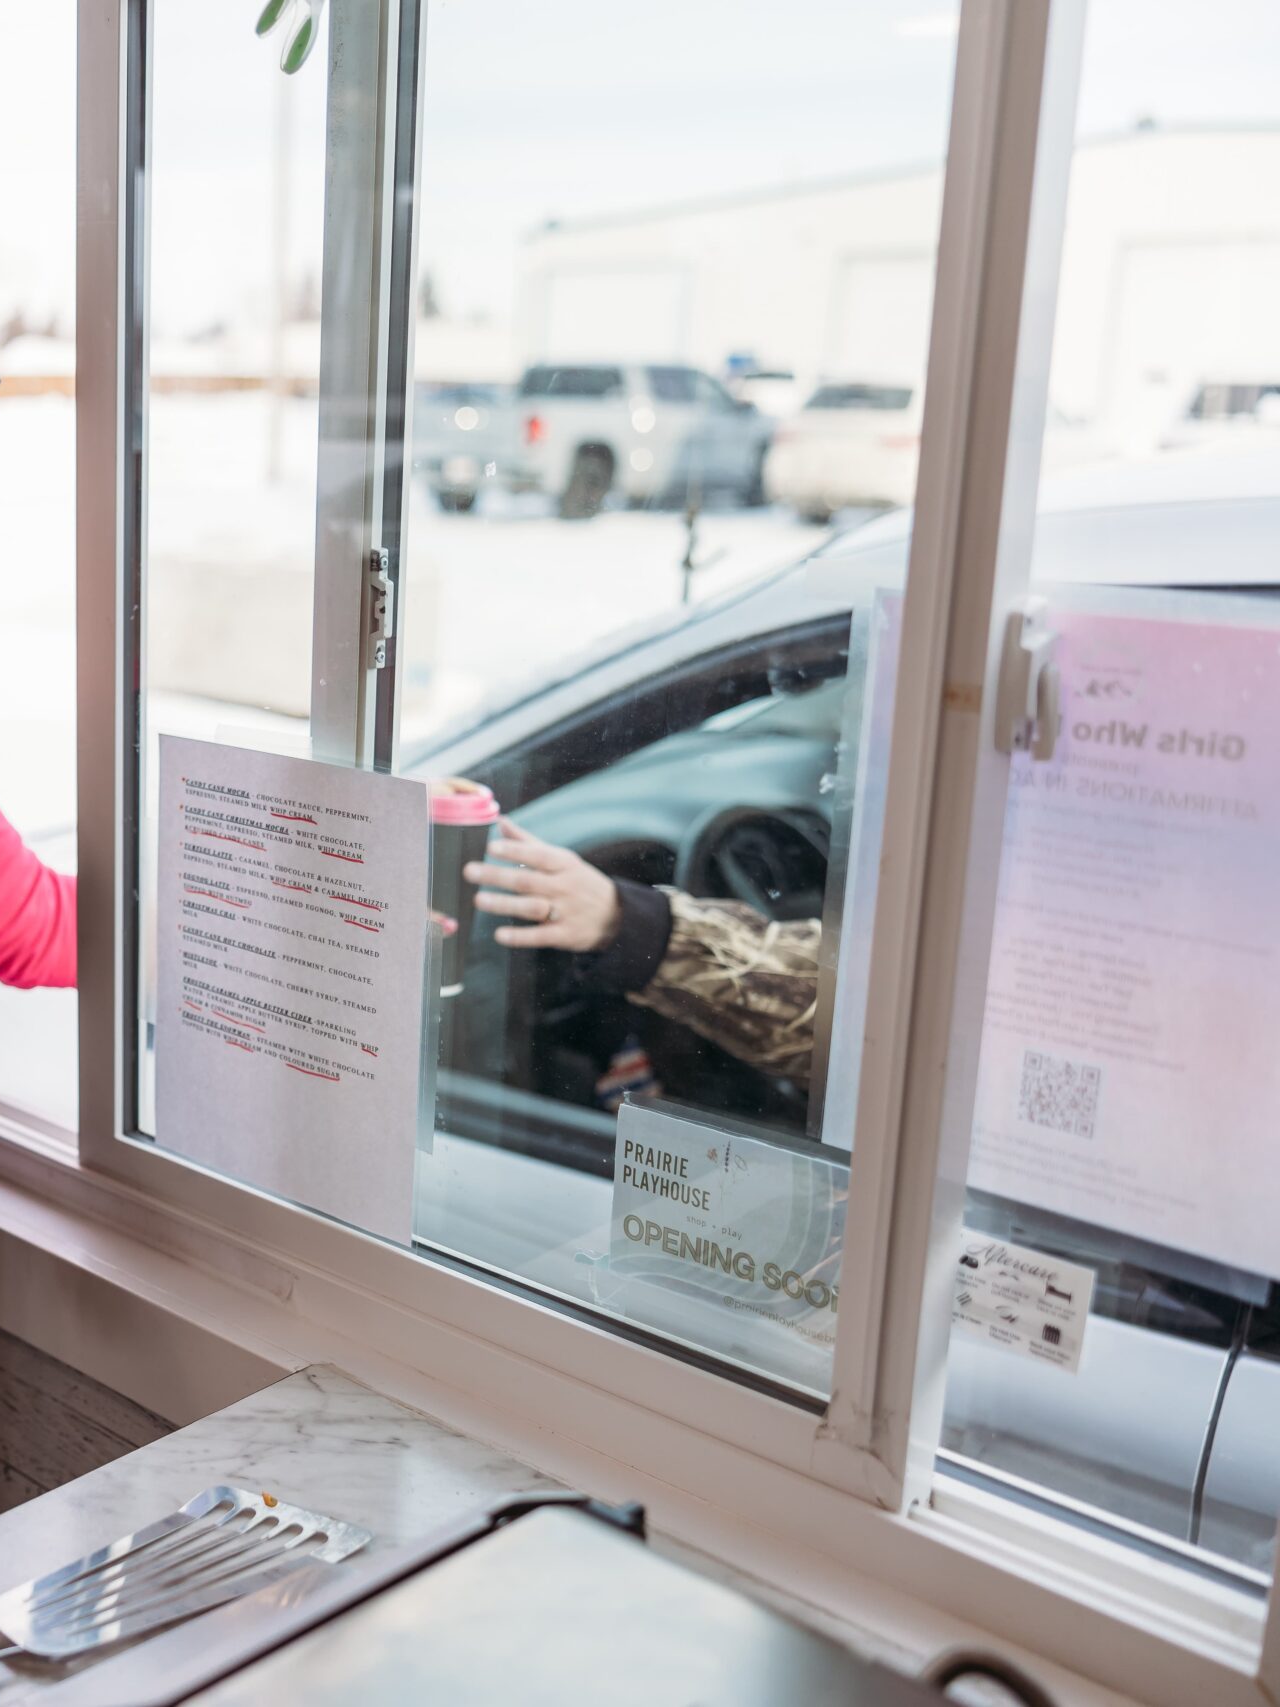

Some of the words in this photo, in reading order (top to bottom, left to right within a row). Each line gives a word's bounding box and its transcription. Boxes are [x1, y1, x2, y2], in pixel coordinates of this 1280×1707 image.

[220, 796, 249, 807] STEAMED
[251, 803, 267, 811] MILK
[270, 807, 287, 815] WHIP
[289, 809, 312, 820] CREAM
[227, 788, 250, 799] MOCHA
[256, 794, 295, 807] CHOCOLATE
[299, 803, 323, 813] SAUCE,
[325, 808, 372, 823] PEPPERMINT,
[226, 814, 263, 830] CHRISTMAS
[265, 824, 289, 835] MOCHA
[296, 830, 318, 840] WHITE
[320, 835, 365, 851] CHOCOLATE,
[262, 833, 293, 844] STEAMED
[295, 840, 315, 850] MILK,
[317, 845, 335, 853] WHIP
[337, 850, 362, 860] CREAM
[270, 875, 286, 885] WHIP
[288, 880, 312, 890] CREAM
[322, 888, 355, 901] CARAMEL
[358, 897, 389, 909] DRIZZLE
[275, 865, 314, 879] CHOCOLATE
[324, 877, 365, 892] HAZELNUT,
[272, 895, 303, 908] STEAMED
[306, 904, 337, 917] EGGNOG,
[339, 912, 357, 921] WHIP
[359, 918, 384, 928] CREAM
[242, 916, 261, 926] WHITE
[264, 922, 306, 939] CHOCOLATE,
[308, 935, 325, 943] CHAI
[328, 939, 343, 949] TEA,
[345, 944, 380, 958] STEAMED
[238, 942, 276, 959] CHOCOLATE
[283, 955, 326, 972] PEPPERMINT,
[329, 968, 373, 985] CHOCOLATE,
[245, 970, 285, 987] CHOCOLATE,
[287, 983, 314, 995] CHERRY
[316, 992, 340, 1004] SYRUP,
[343, 1000, 377, 1014] STEAMED
[242, 997, 262, 1008] APPLE
[264, 1003, 289, 1017] BUTTER
[291, 1011, 312, 1024] CIDER
[285, 1019, 308, 1032] SYRUP,
[311, 1027, 337, 1040] TOPPED
[339, 1036, 358, 1047] WITH
[360, 1042, 379, 1052] WHIP
[257, 1037, 286, 1051] STEAMER
[289, 1048, 305, 1057] WITH
[308, 1054, 329, 1065] WHITE
[331, 1062, 375, 1080] CHOCOLATE
[264, 1049, 277, 1057] AND
[279, 1054, 315, 1070] COLOURED
[317, 1067, 340, 1078] SUGAR
[624, 1140, 689, 1178] PRAIRIE
[622, 1164, 710, 1211] PLAYHOUSE
[686, 1215, 706, 1228] shop
[722, 1227, 742, 1240] play
[622, 1214, 756, 1282] OPENING
[966, 1244, 1058, 1281] Aftercare
